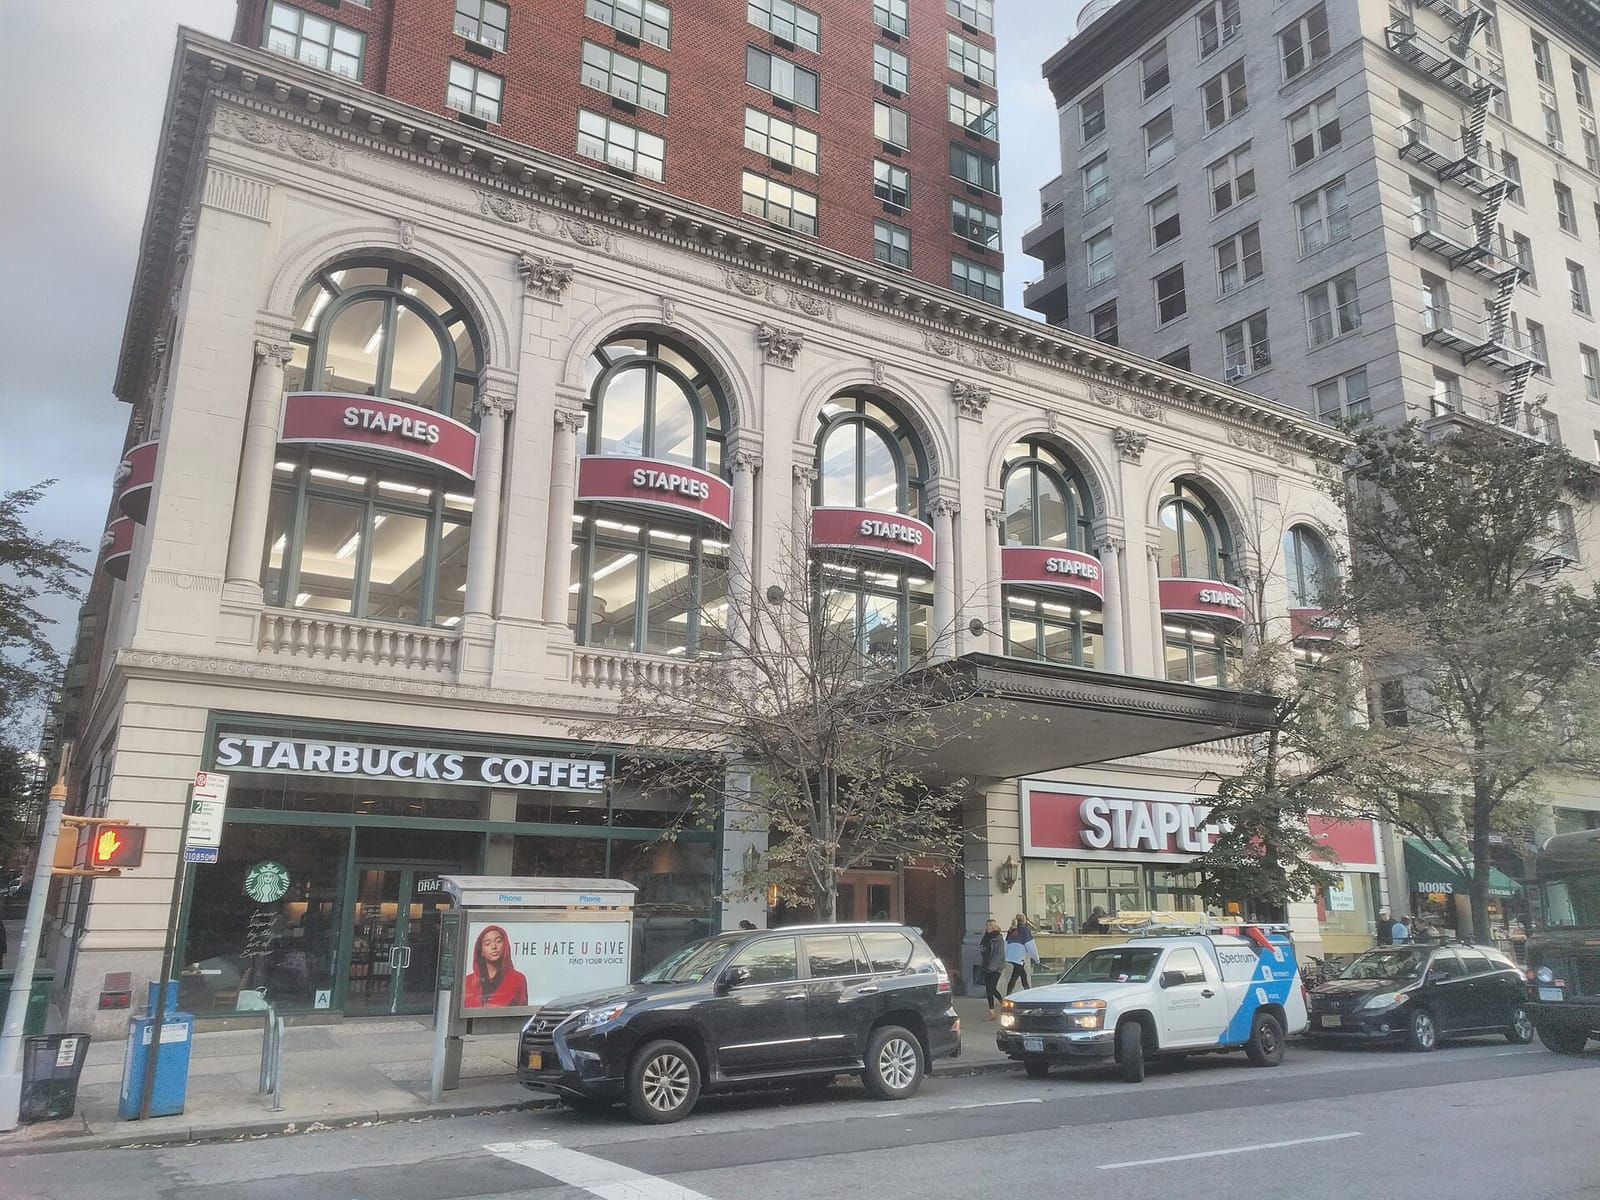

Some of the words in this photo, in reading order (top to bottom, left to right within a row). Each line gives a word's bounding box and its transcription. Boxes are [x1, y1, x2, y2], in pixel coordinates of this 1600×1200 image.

[343, 407, 440, 445] STAPLES
[632, 467, 709, 500] STAPLES
[860, 518, 923, 546] STAPLES
[1046, 557, 1099, 581] STAPLES
[216, 735, 465, 782] STARBUCKS
[480, 756, 606, 790] COFFEE
[196, 802, 201, 813] 2
[1079, 797, 1236, 853] STAPLE
[417, 880, 443, 892] DRAF
[1418, 882, 1453, 894] BOOKS
[499, 894, 522, 902] Phone
[579, 895, 601, 903] Phone
[514, 942, 537, 956] THE
[544, 941, 574, 955] HATE
[581, 942, 588, 955] U
[595, 941, 624, 955] GIVE
[569, 958, 584, 966] FIND
[603, 957, 624, 965] VOICE
[1219, 952, 1255, 965] Spectrum
[318, 993, 327, 1003] A
